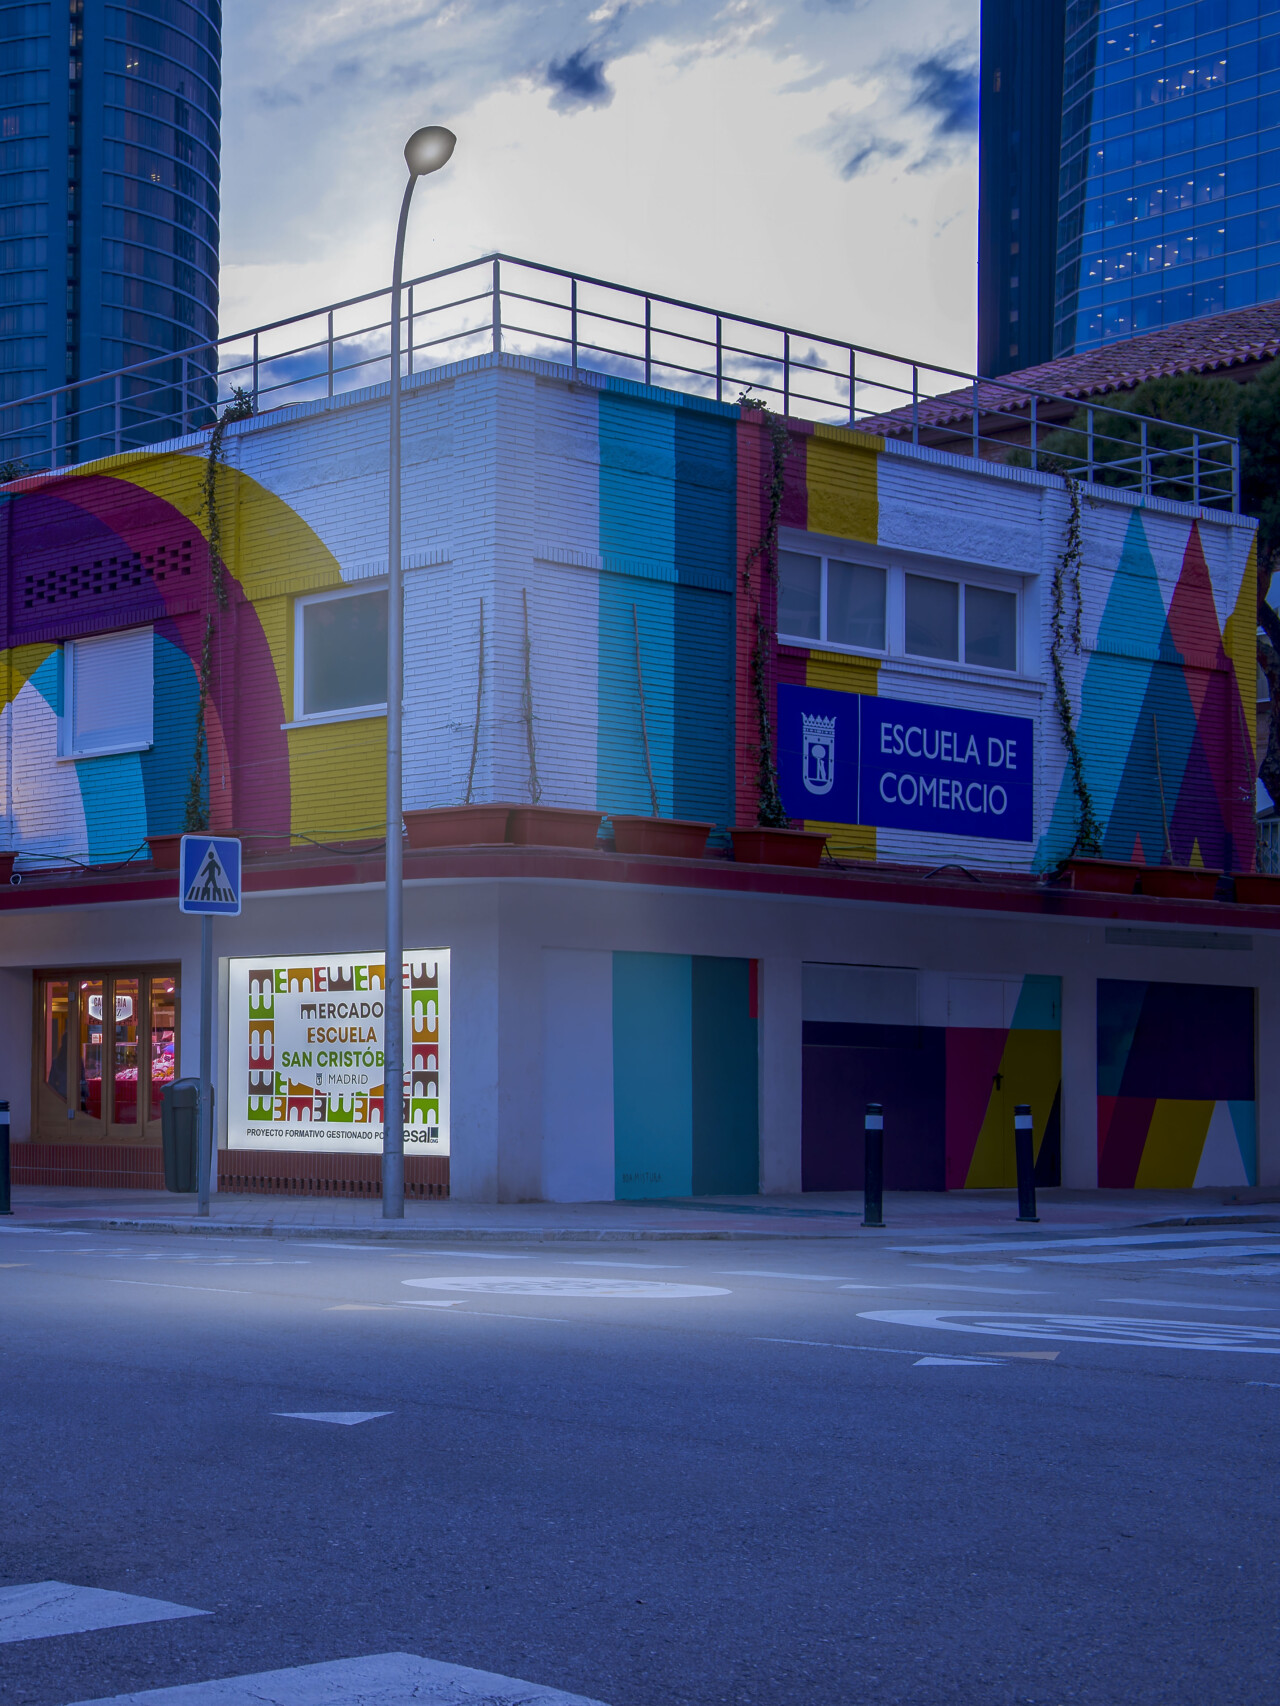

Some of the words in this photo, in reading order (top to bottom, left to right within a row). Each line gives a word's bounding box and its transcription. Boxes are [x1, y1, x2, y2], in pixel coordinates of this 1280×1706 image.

[880, 721, 981, 765] ESCUELA
[987, 736, 1017, 770] DE
[879, 771, 1008, 815] COMERCIO
[300, 1001, 384, 1020] MERCADO
[307, 1027, 377, 1043] ESCUELA
[281, 1051, 312, 1067] SAN
[316, 1046, 384, 1067] CRISTÓB
[328, 1074, 369, 1085] MADRID
[246, 1128, 283, 1137] PROYECTO
[285, 1129, 325, 1138] FORMATIVO
[326, 1130, 372, 1140] GESTIONADO
[374, 1131, 384, 1140] PO
[402, 1127, 430, 1143] esal
